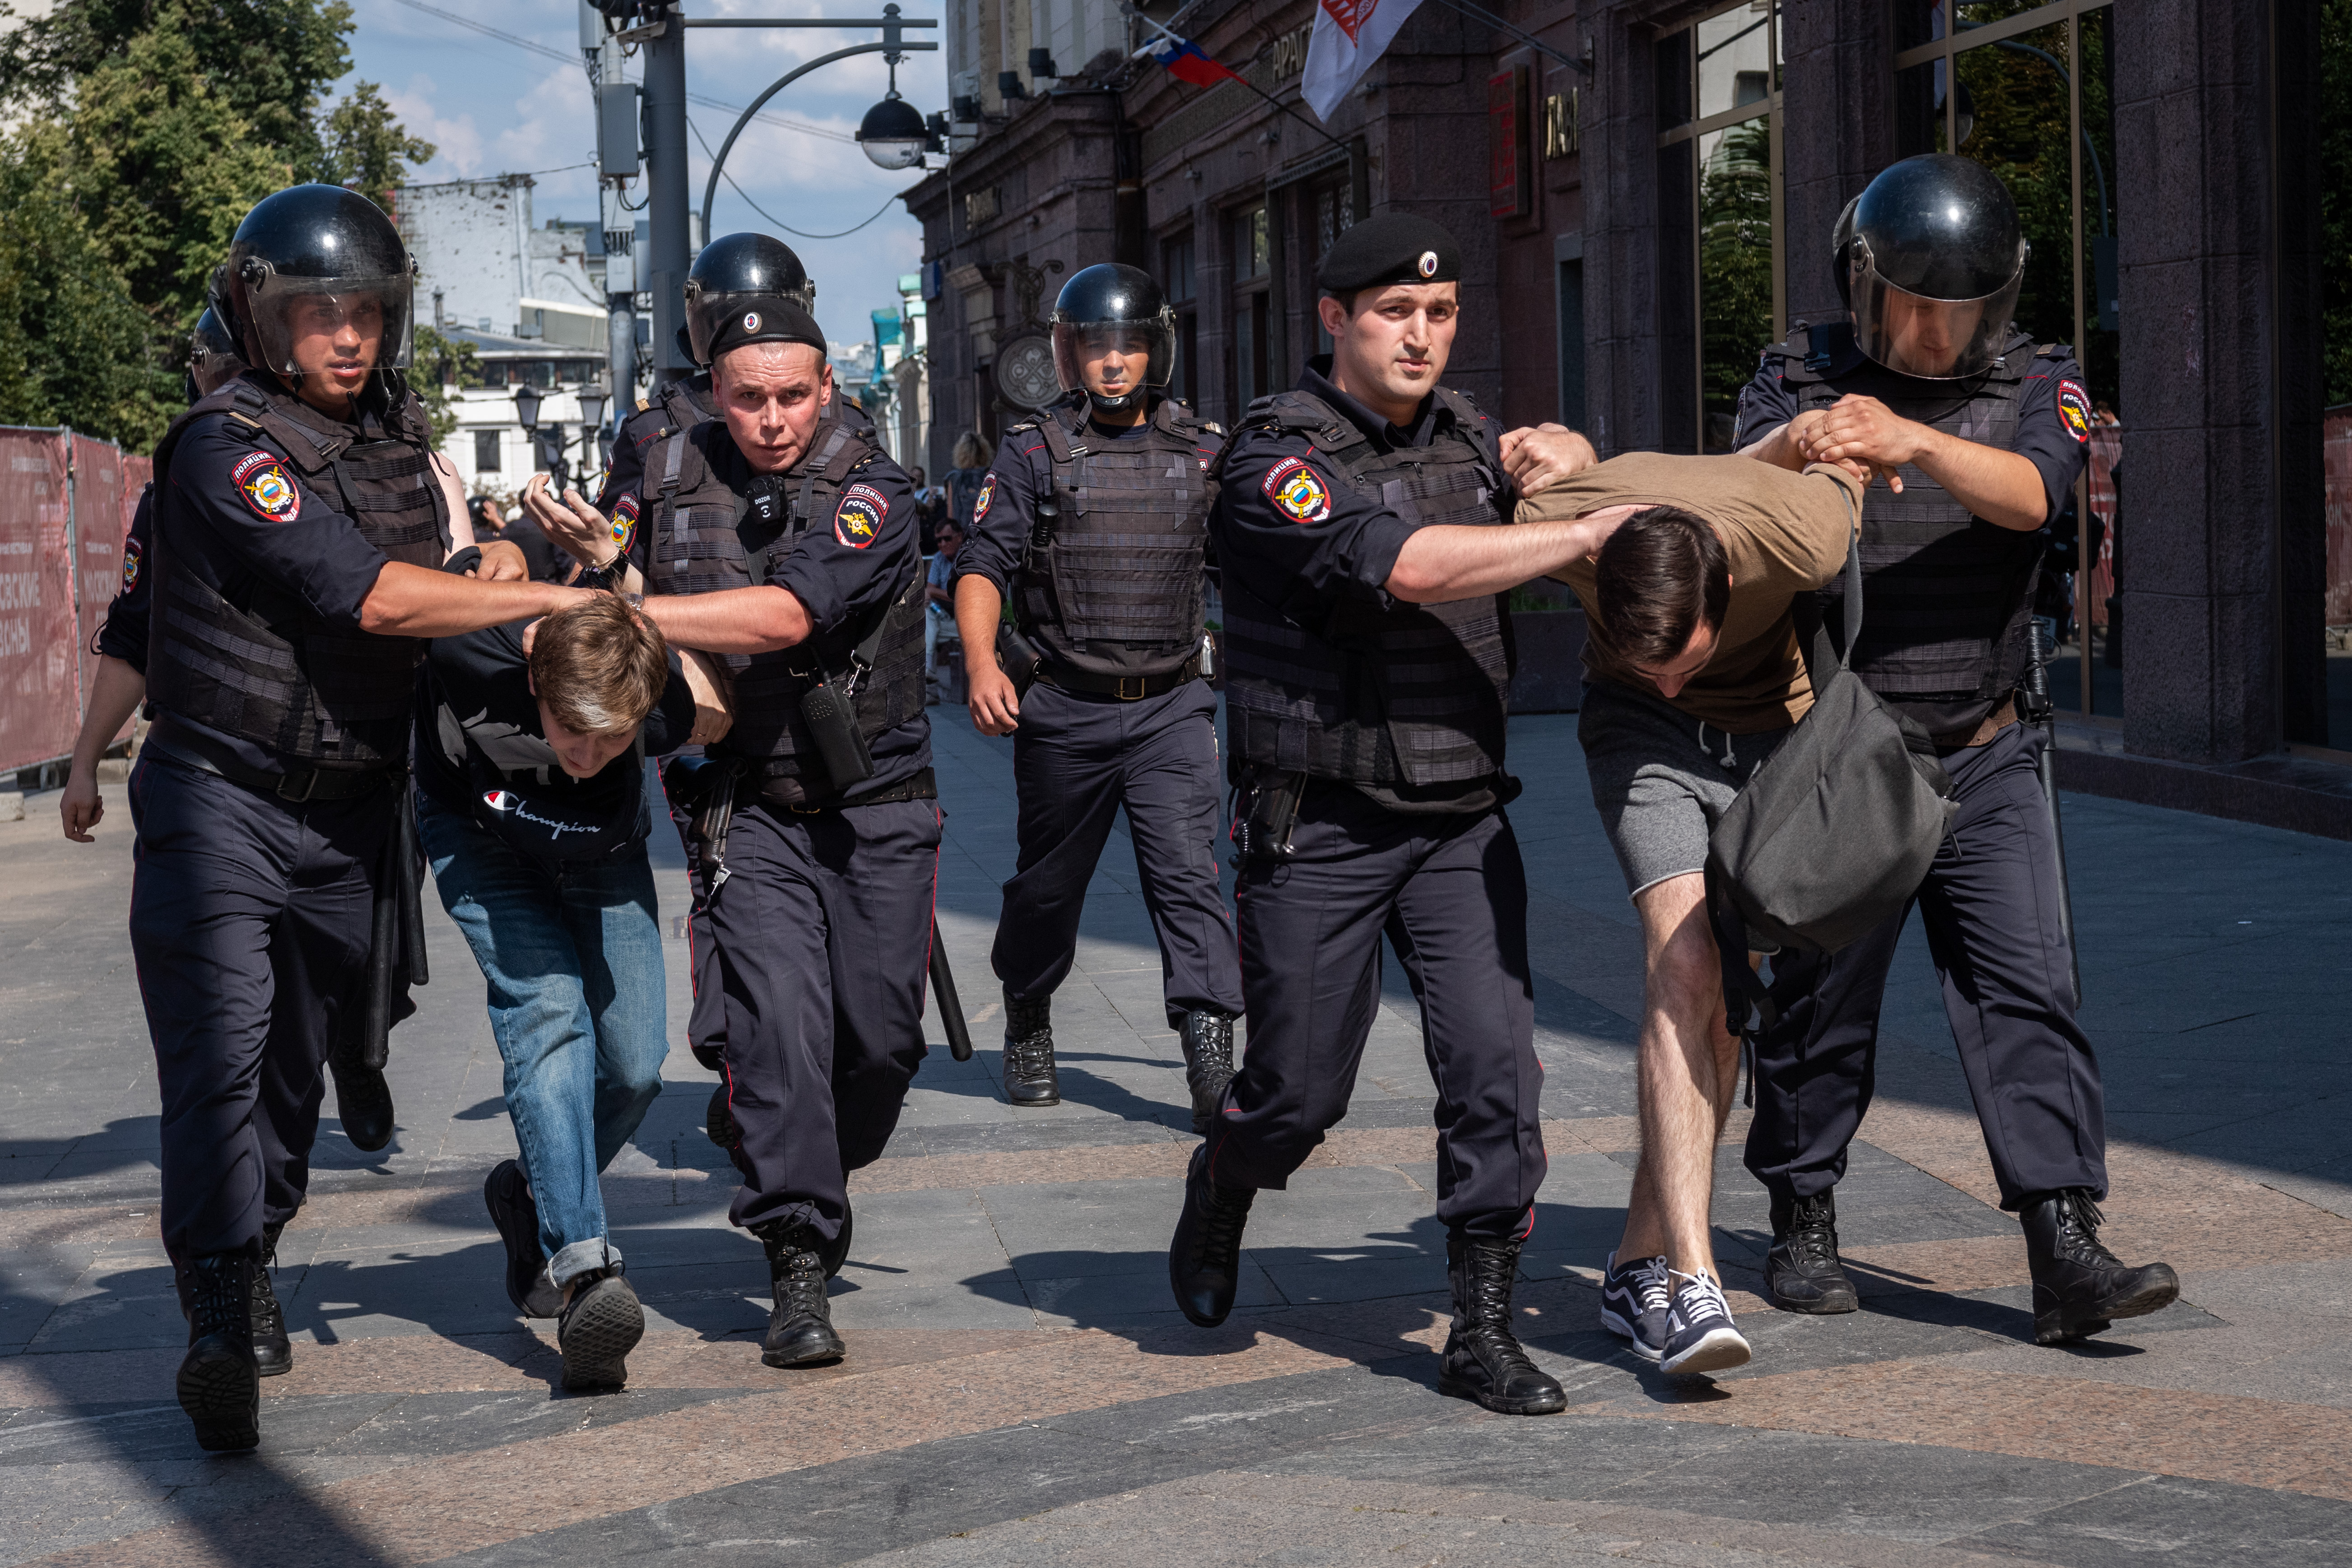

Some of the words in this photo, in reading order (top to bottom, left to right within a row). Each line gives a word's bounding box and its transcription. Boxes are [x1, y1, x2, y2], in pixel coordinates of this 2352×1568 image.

[2063, 382, 2090, 408] ПОЛИЦИЯ
[2063, 394, 2088, 420] РОССИЯ
[234, 452, 271, 479] ПОЛИЦИЯ
[1264, 458, 1298, 491] ПОЛИЦИЯ
[619, 495, 639, 512] ПОЛИЦИЯ
[755, 495, 771, 505] DOZOR
[852, 487, 887, 510] ПОЛИЦИЯ
[280, 507, 298, 521] МВД
[846, 501, 879, 524] РОССИЯ
[483, 790, 601, 840] Champion
